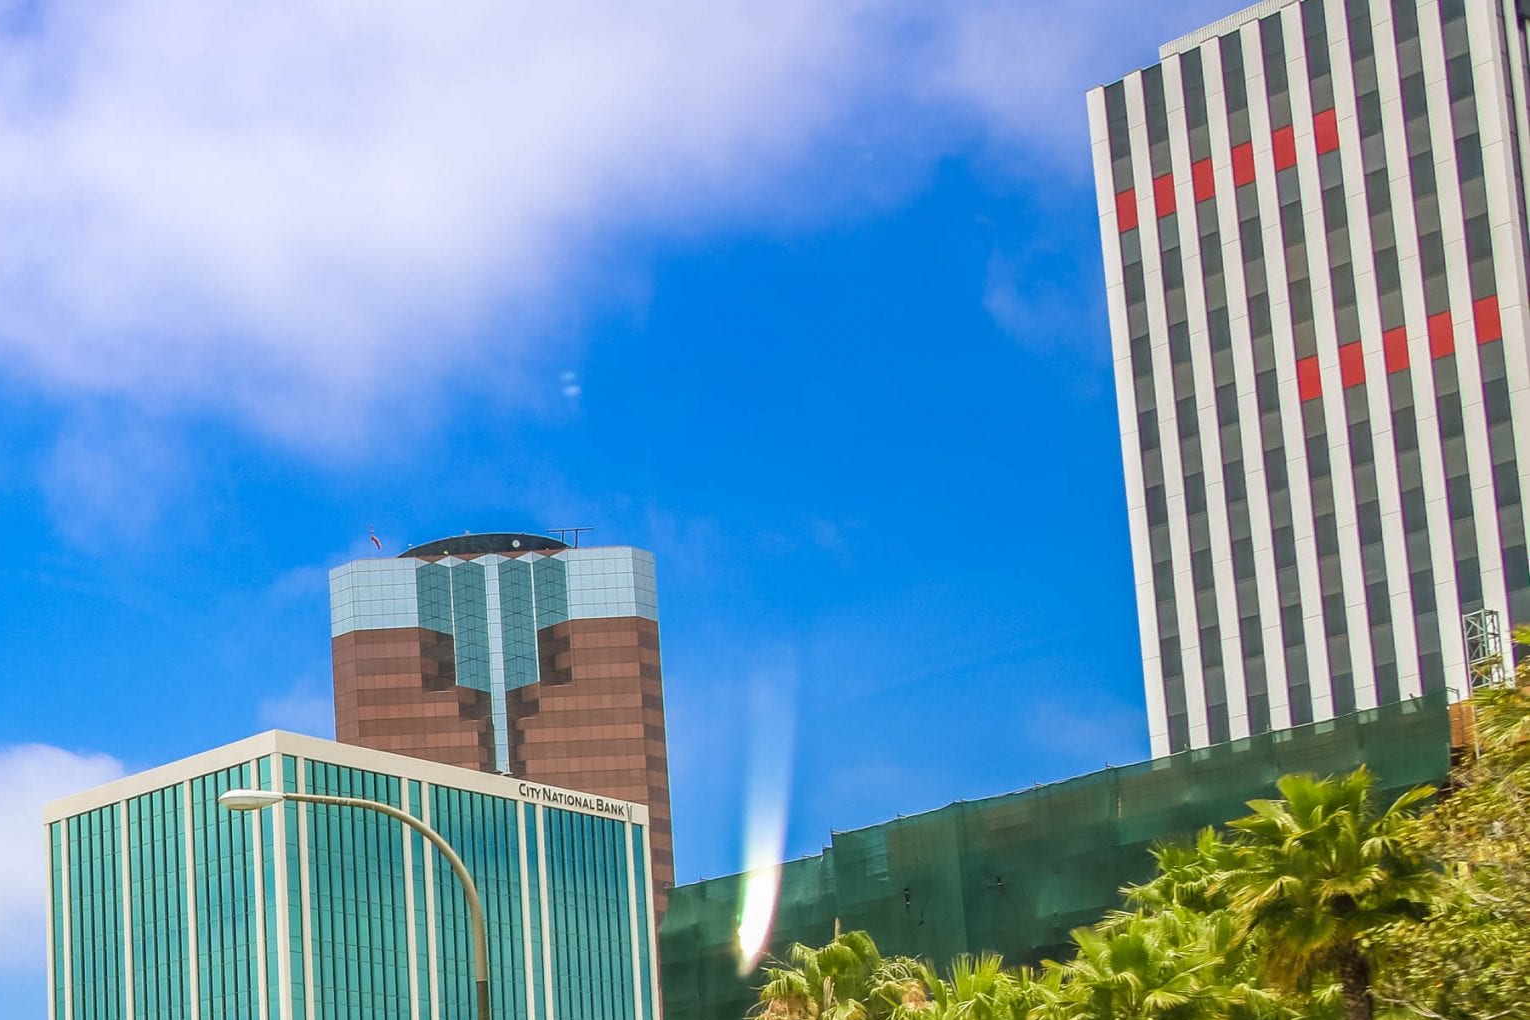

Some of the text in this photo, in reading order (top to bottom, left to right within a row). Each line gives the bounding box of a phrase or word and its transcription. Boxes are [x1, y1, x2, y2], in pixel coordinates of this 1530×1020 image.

[519, 783, 625, 816] CITY NATIONAL BANK
